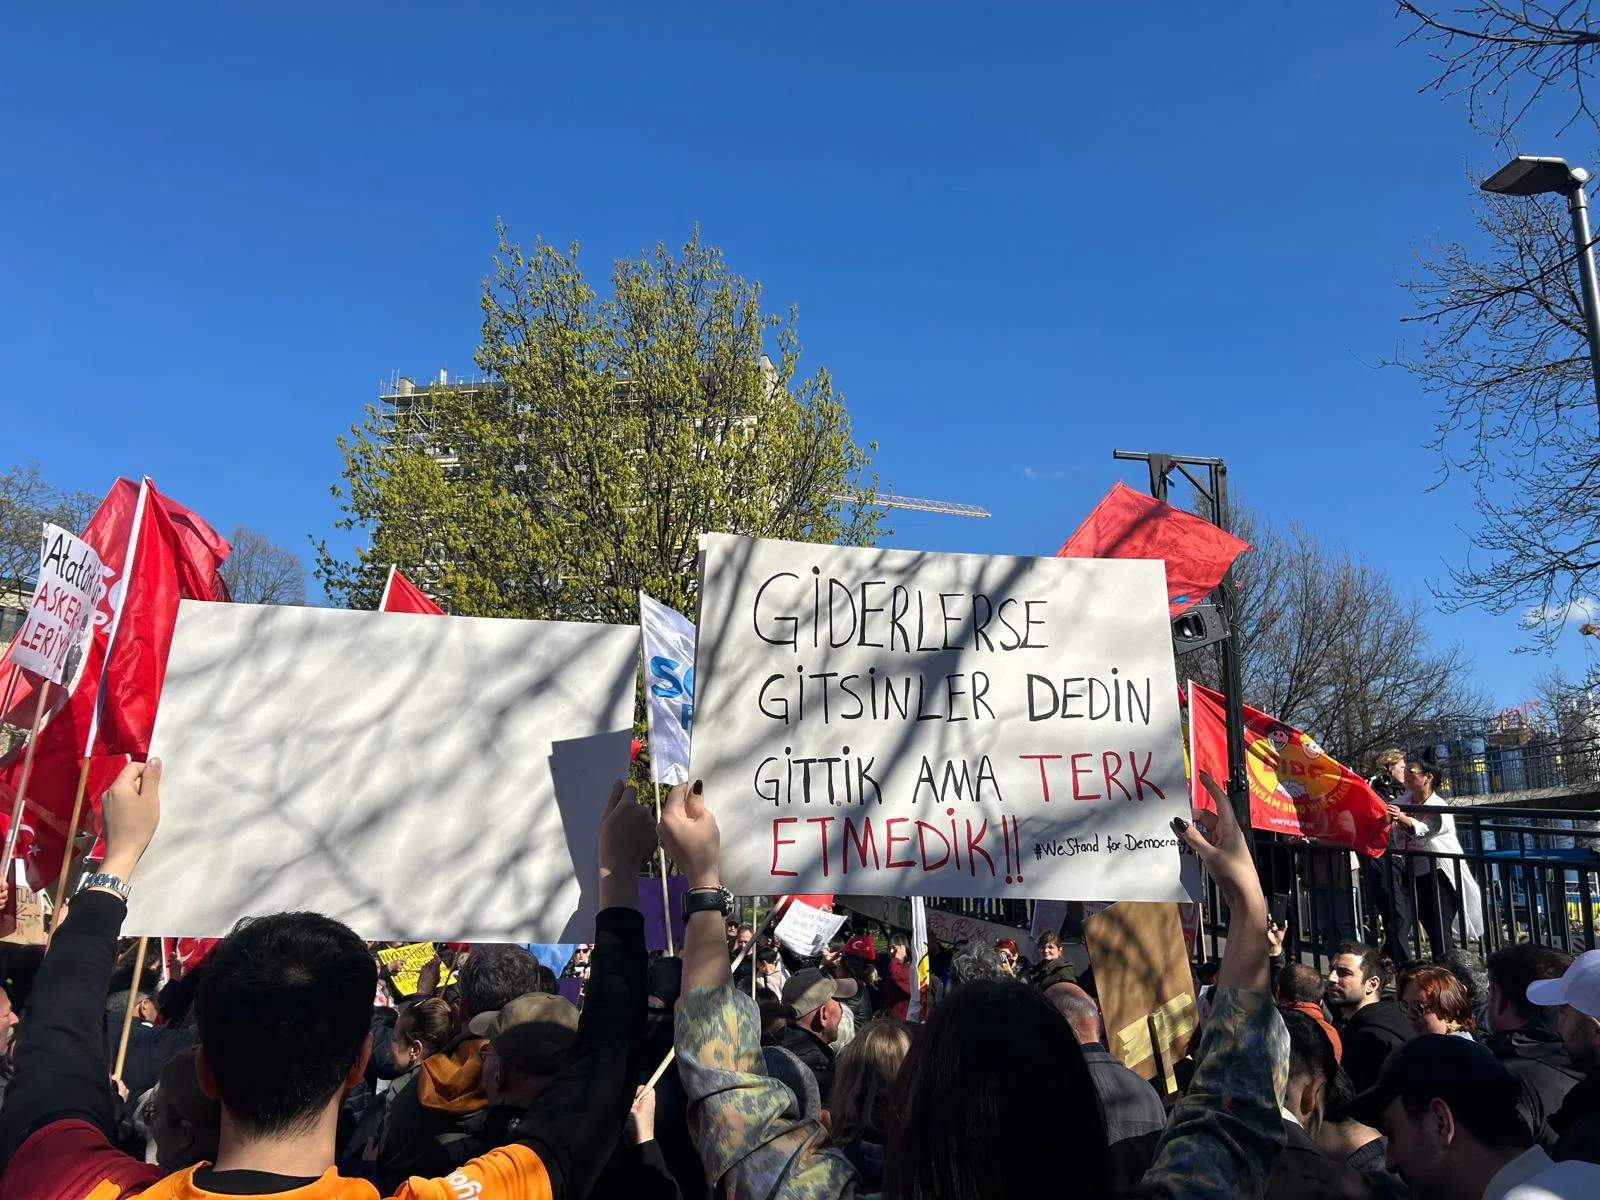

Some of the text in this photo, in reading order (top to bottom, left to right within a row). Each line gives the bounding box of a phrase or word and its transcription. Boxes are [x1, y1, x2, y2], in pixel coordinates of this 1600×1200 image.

[753, 565, 1050, 654] GİDERLERSE
[758, 664, 996, 725] GİTSİNLER
[1027, 667, 1151, 725] DEDİN
[754, 746, 1167, 807] GİTTİK AMA TERK
[770, 807, 1025, 884] ETMEDİK!!
[1106, 835, 1121, 854] for
